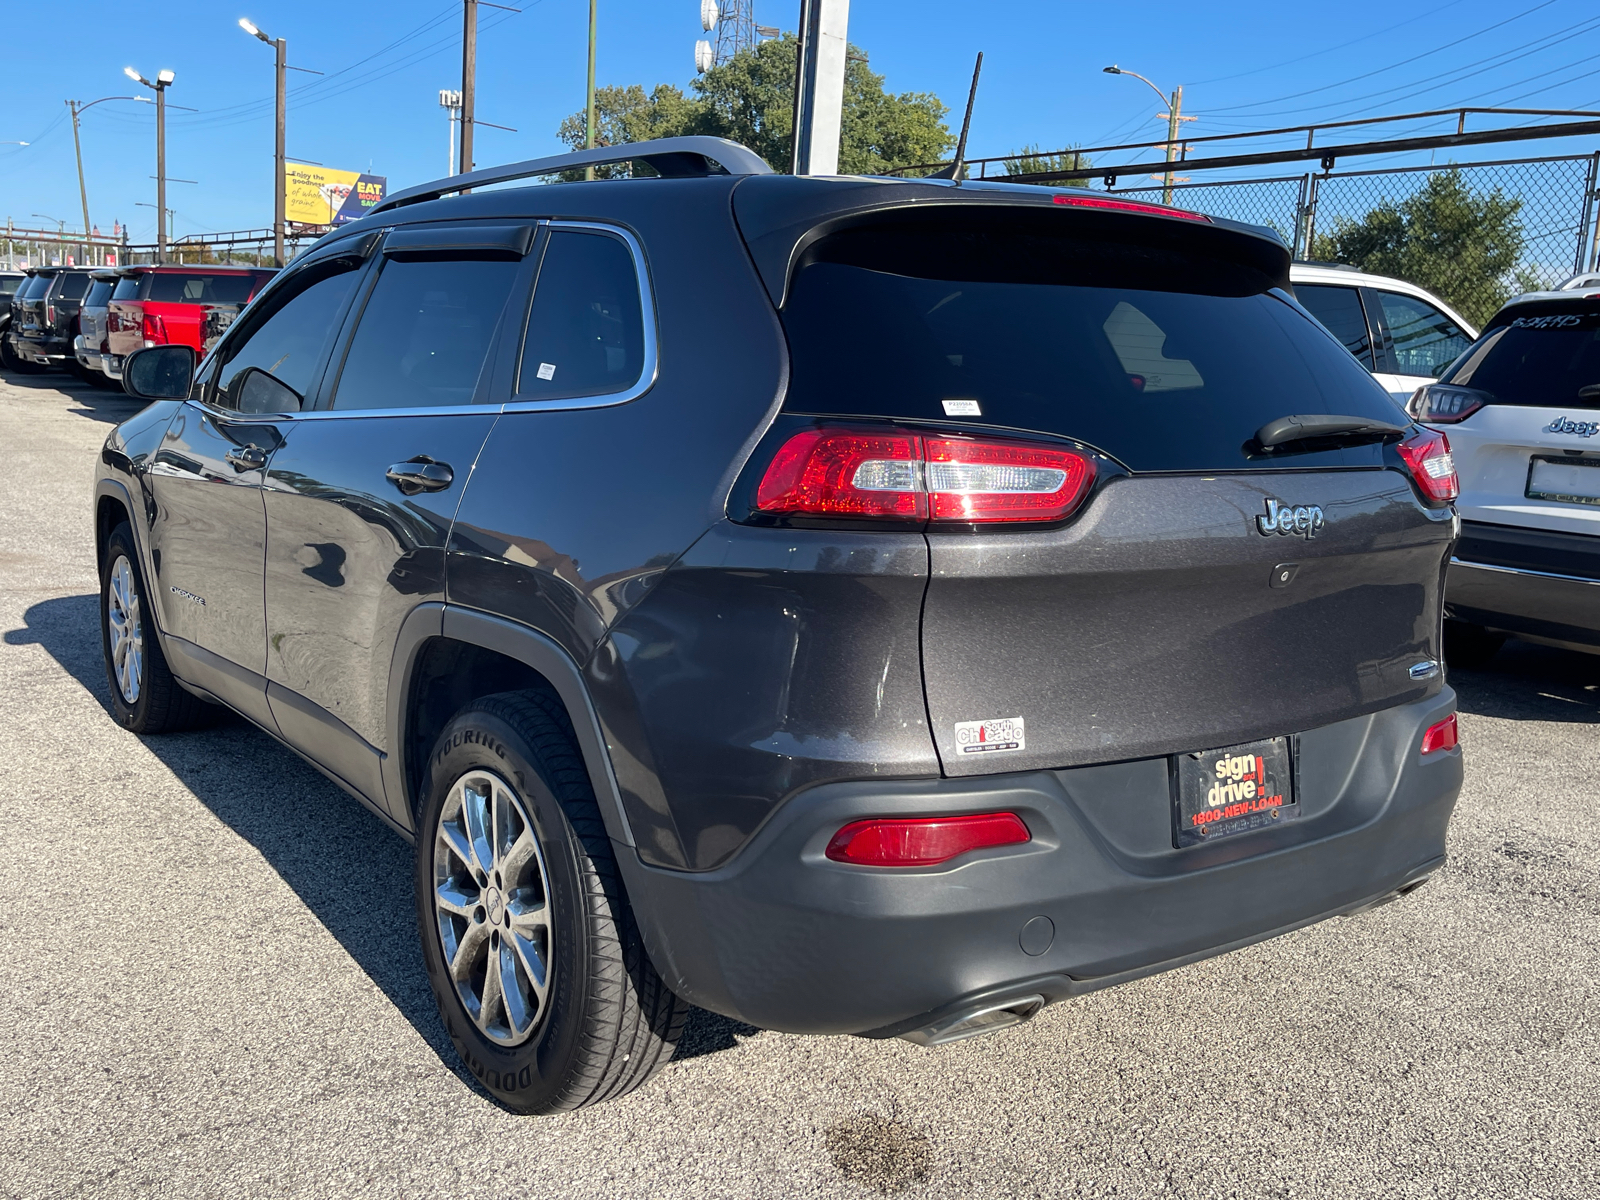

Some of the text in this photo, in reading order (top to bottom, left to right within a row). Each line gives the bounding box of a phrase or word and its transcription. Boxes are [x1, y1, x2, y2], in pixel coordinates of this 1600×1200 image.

[292, 171, 312, 180] Enjoy
[292, 178, 325, 188] goodness
[357, 181, 383, 196] EAT.
[292, 187, 322, 200] of whole
[360, 199, 379, 207] SAV
[1548, 416, 1599, 438] Jeep
[1255, 497, 1324, 540] Jeep
[984, 719, 1013, 733] South
[437, 729, 506, 765] TOURING
[1215, 753, 1256, 781] sign
[1243, 772, 1256, 781] and
[1192, 794, 1283, 826] 1800-NEW-LOAN
